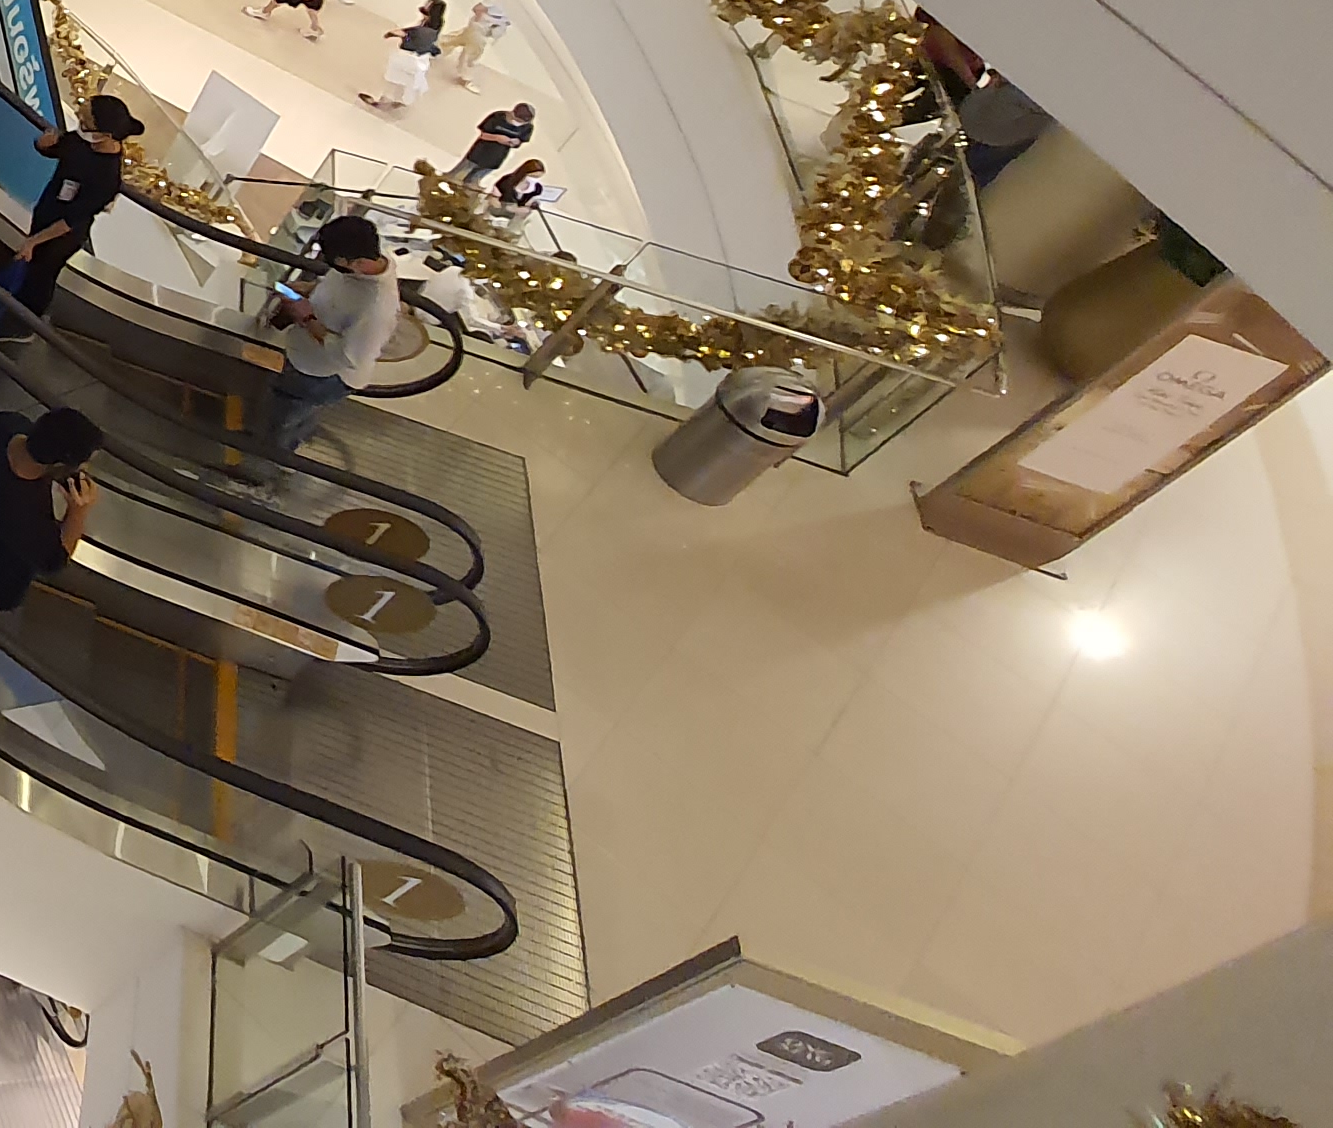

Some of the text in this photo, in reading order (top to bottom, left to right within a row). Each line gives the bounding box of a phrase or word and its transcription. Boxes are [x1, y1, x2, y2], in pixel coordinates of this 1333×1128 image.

[364, 521, 392, 545] 1
[354, 590, 396, 624] 1
[380, 876, 423, 906] 1
